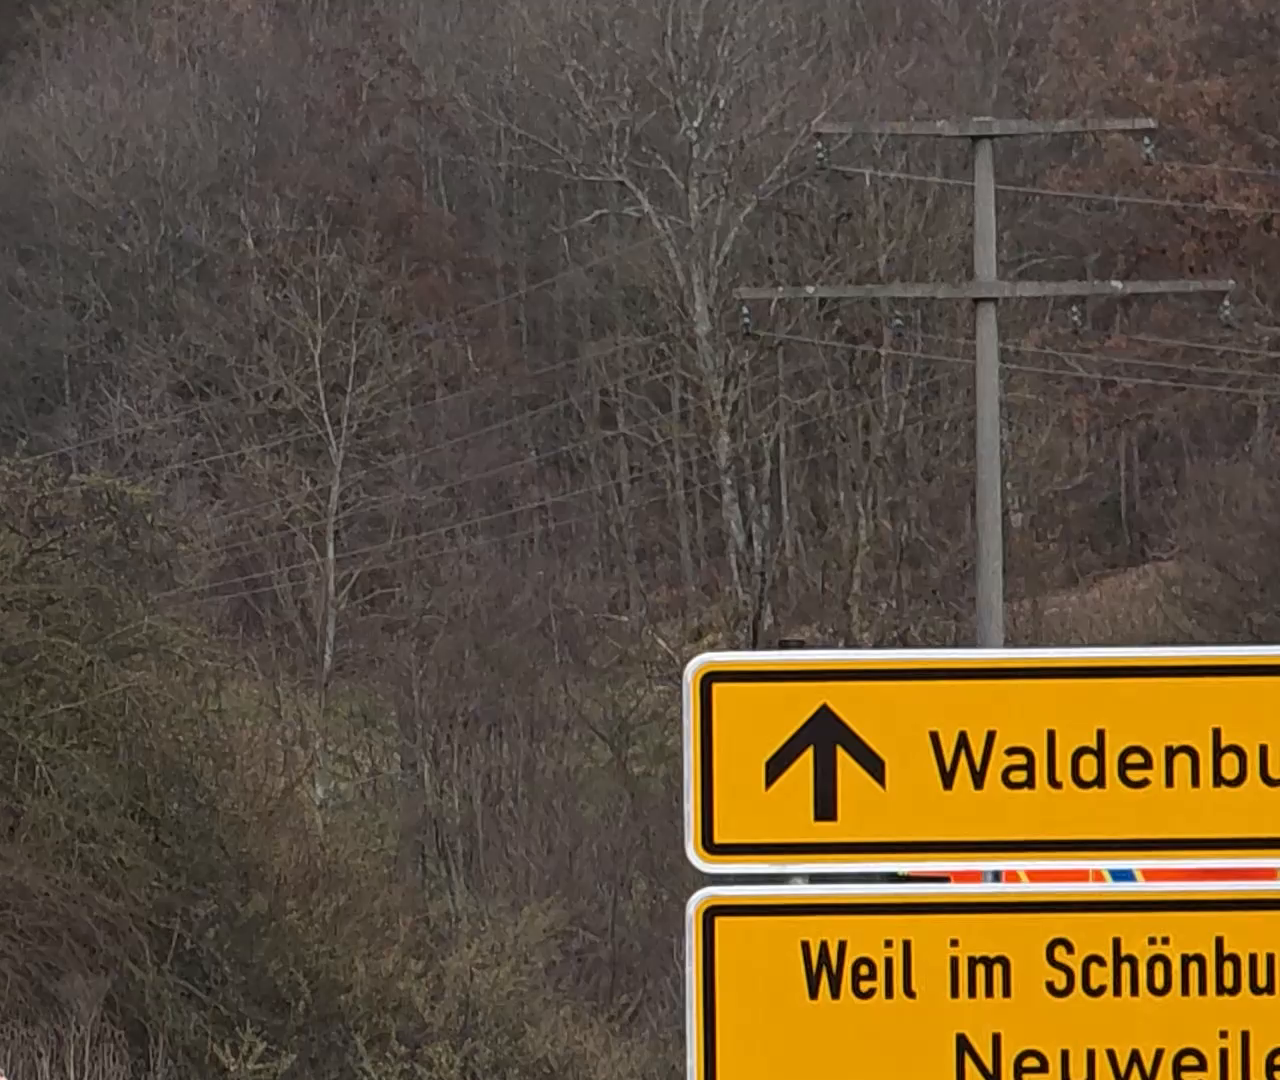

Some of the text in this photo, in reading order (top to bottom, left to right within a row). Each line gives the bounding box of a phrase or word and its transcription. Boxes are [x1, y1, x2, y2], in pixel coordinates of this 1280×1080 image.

[800, 935, 1276, 1001] Weil im Schönbu
